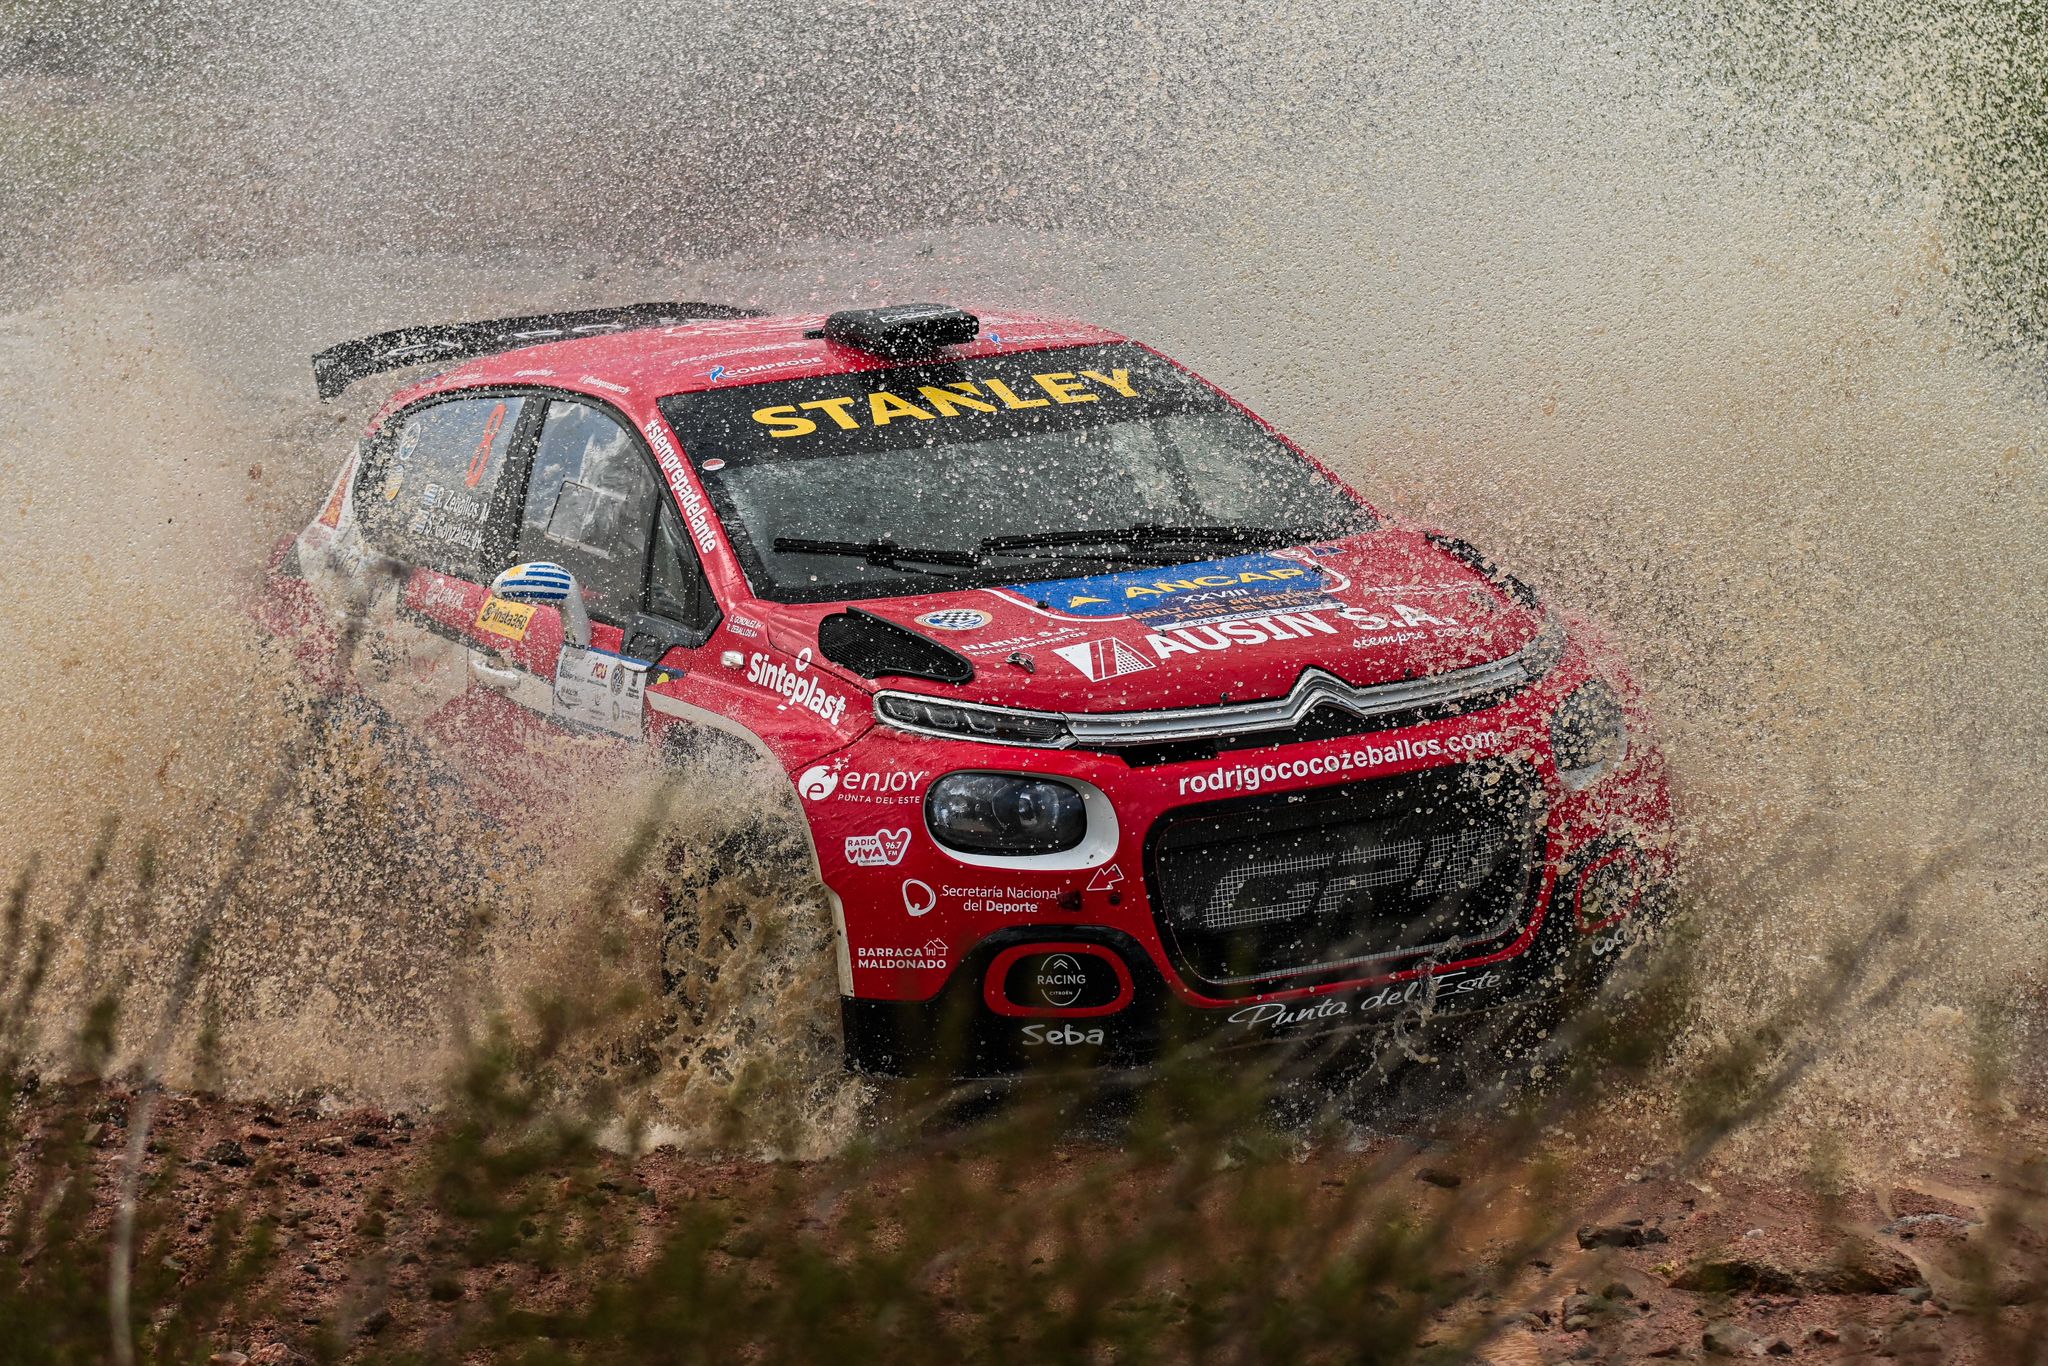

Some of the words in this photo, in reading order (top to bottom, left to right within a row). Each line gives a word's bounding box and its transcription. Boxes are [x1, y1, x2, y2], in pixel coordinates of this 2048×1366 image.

[726, 357, 823, 376] COMPRODE
[752, 368, 1138, 438] STANLEY
[466, 402, 507, 488] 8
[644, 418, 717, 554] #siemprepadelante
[1125, 568, 1305, 599] ANCAP
[1179, 588, 1250, 603] XXVIII
[1130, 607, 1183, 620] RALLY
[1190, 600, 1225, 611] DEL
[1145, 612, 1339, 660] AUSIN
[1353, 630, 1428, 648] siempre
[747, 652, 847, 726] Sinteplast
[1179, 731, 1500, 796] rodrigococozeballos.com
[838, 793, 872, 803] PUNTA
[875, 795, 894, 805] DEL
[898, 795, 921, 804] ESTE
[847, 838, 877, 847] RADIO
[941, 884, 1003, 899] Secretaría
[1007, 887, 1060, 900] Nacional
[963, 900, 982, 912] del
[986, 901, 1038, 915] Deporte
[858, 947, 923, 958] BARRACA
[858, 959, 947, 969] MALDONADO
[1037, 974, 1086, 986] RACING
[1227, 998, 1347, 1030] Punta
[1361, 981, 1416, 1011] del
[1021, 1023, 1105, 1047] Seba
